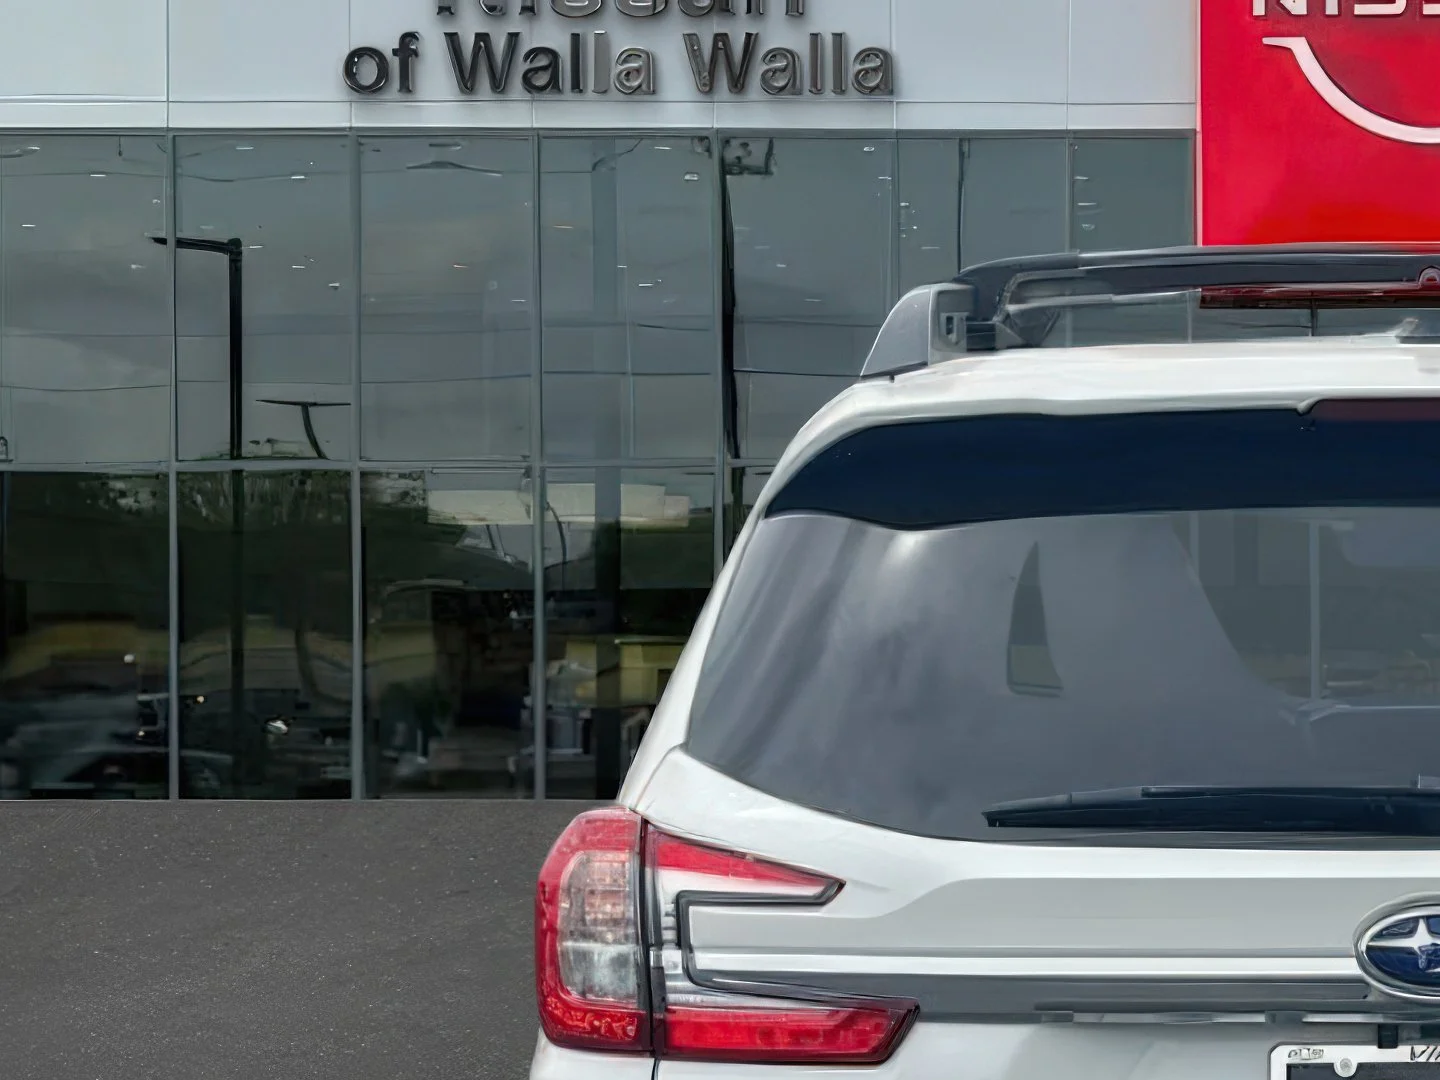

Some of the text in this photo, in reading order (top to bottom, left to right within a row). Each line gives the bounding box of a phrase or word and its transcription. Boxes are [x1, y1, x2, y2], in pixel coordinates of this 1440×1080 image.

[342, 31, 895, 95] of Walla Walla
